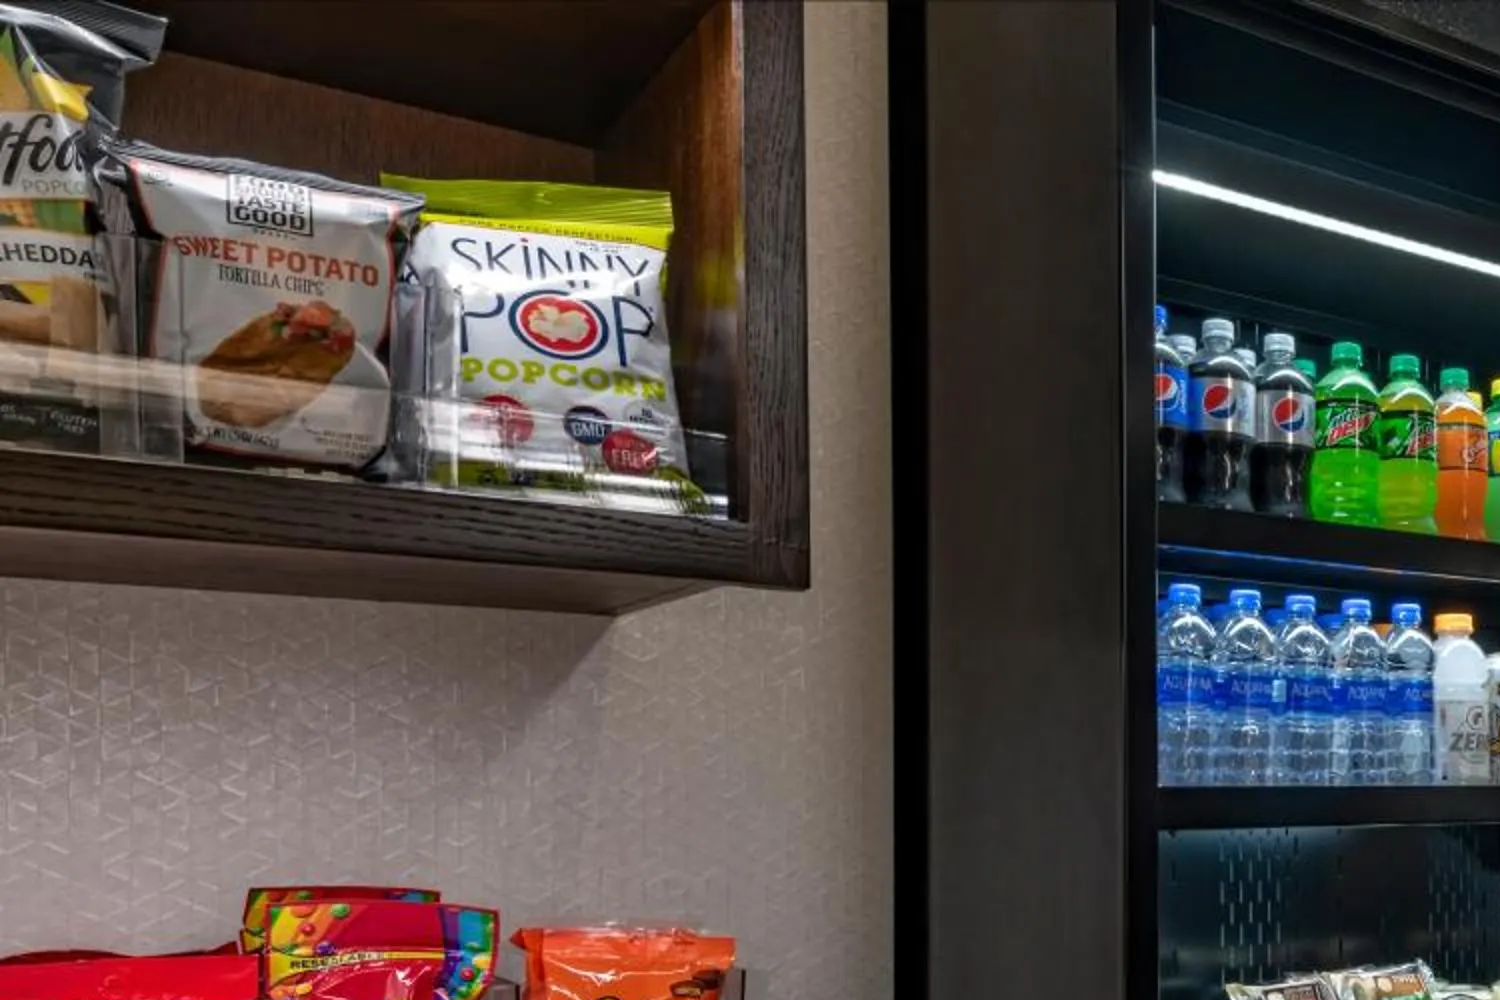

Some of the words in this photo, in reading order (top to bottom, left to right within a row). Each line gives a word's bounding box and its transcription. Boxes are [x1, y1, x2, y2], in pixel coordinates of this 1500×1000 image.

[235, 205, 305, 231] GOOD
[0, 242, 96, 271] HEDDA
[172, 235, 259, 264] SWEET
[266, 245, 380, 288] POTATO
[217, 262, 282, 290] TORTILLA
[284, 275, 325, 297] CHIPS
[460, 357, 668, 401] POPCORN
[1449, 733, 1487, 752] ZER
